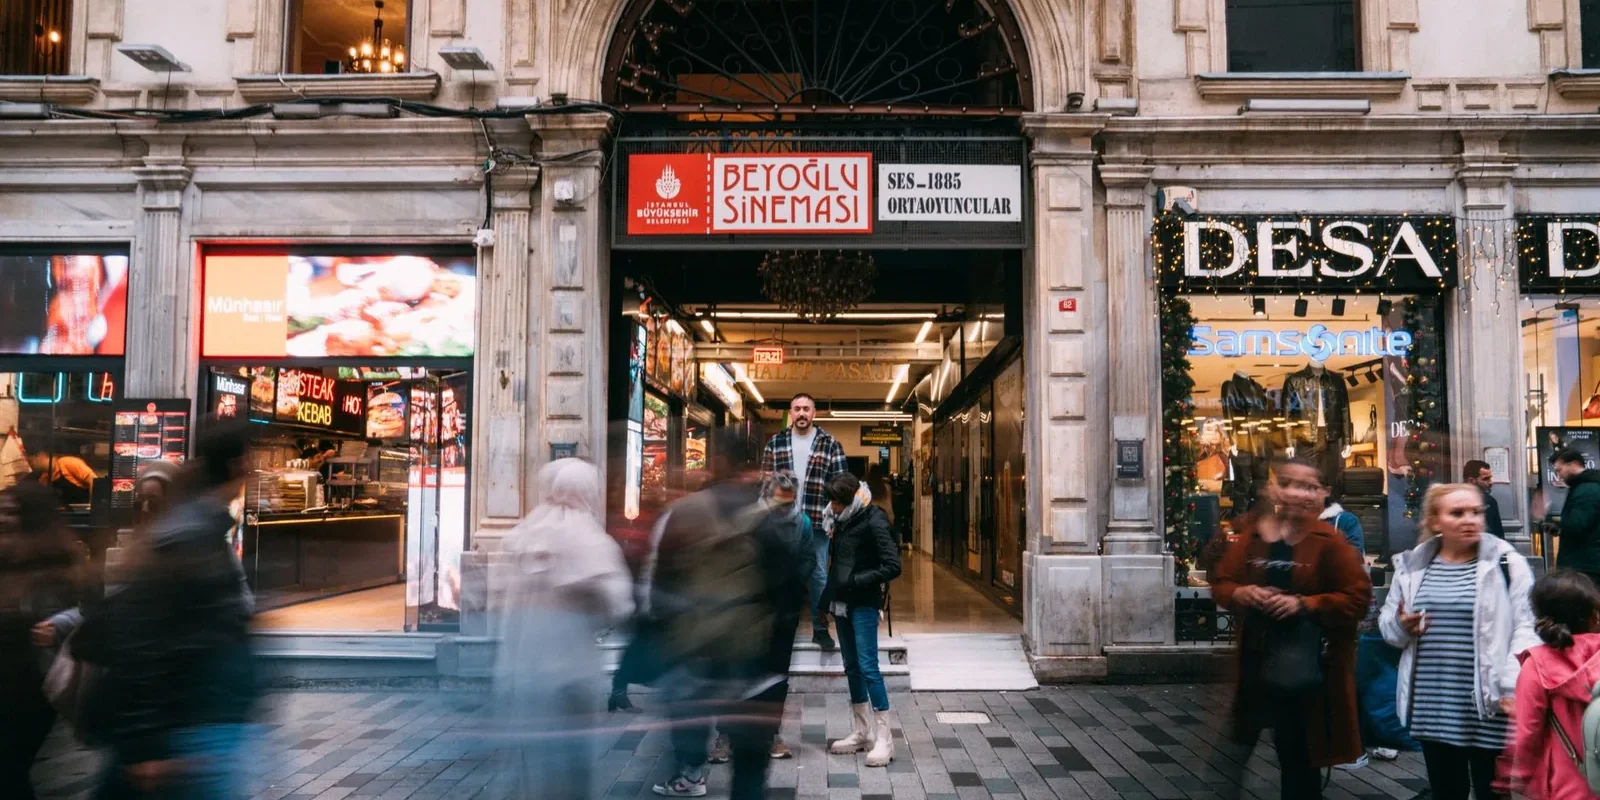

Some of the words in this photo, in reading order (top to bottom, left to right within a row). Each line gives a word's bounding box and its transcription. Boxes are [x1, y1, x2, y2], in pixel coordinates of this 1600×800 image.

[723, 159, 858, 191] BEYOĞLU
[887, 197, 1012, 215] ORTAOYUNCULAR
[1183, 220, 1443, 278] DESA
[1186, 324, 1412, 361] Samsonite
[746, 363, 813, 380] HALEP
[300, 373, 334, 401] STEAK
[298, 402, 332, 425] KEBAB
